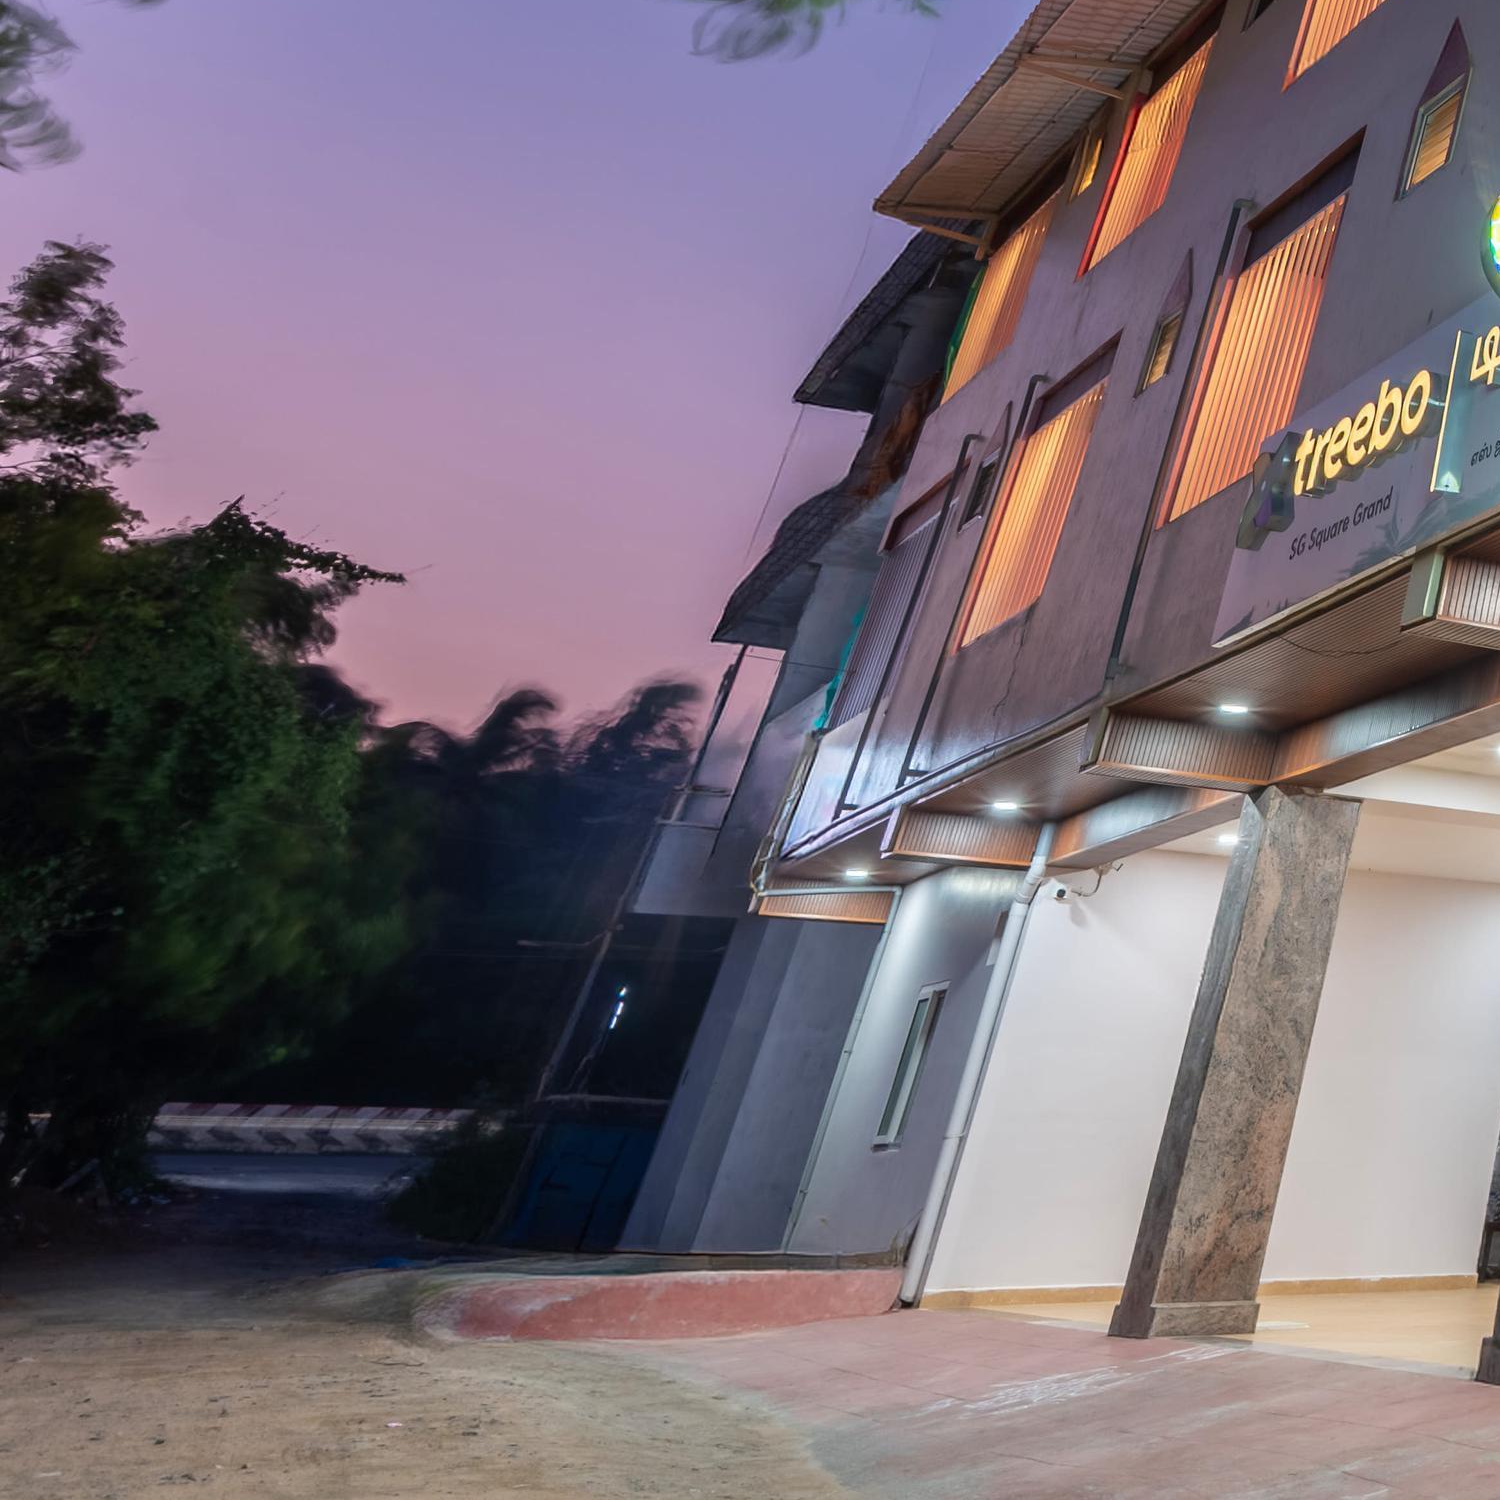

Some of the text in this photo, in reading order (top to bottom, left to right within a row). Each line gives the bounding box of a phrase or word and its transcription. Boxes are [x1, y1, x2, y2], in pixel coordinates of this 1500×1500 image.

[1293, 369, 1431, 496] treebo
[1471, 442, 1493, 467] எஸ்
[1289, 485, 1394, 560] SG Square Grand
